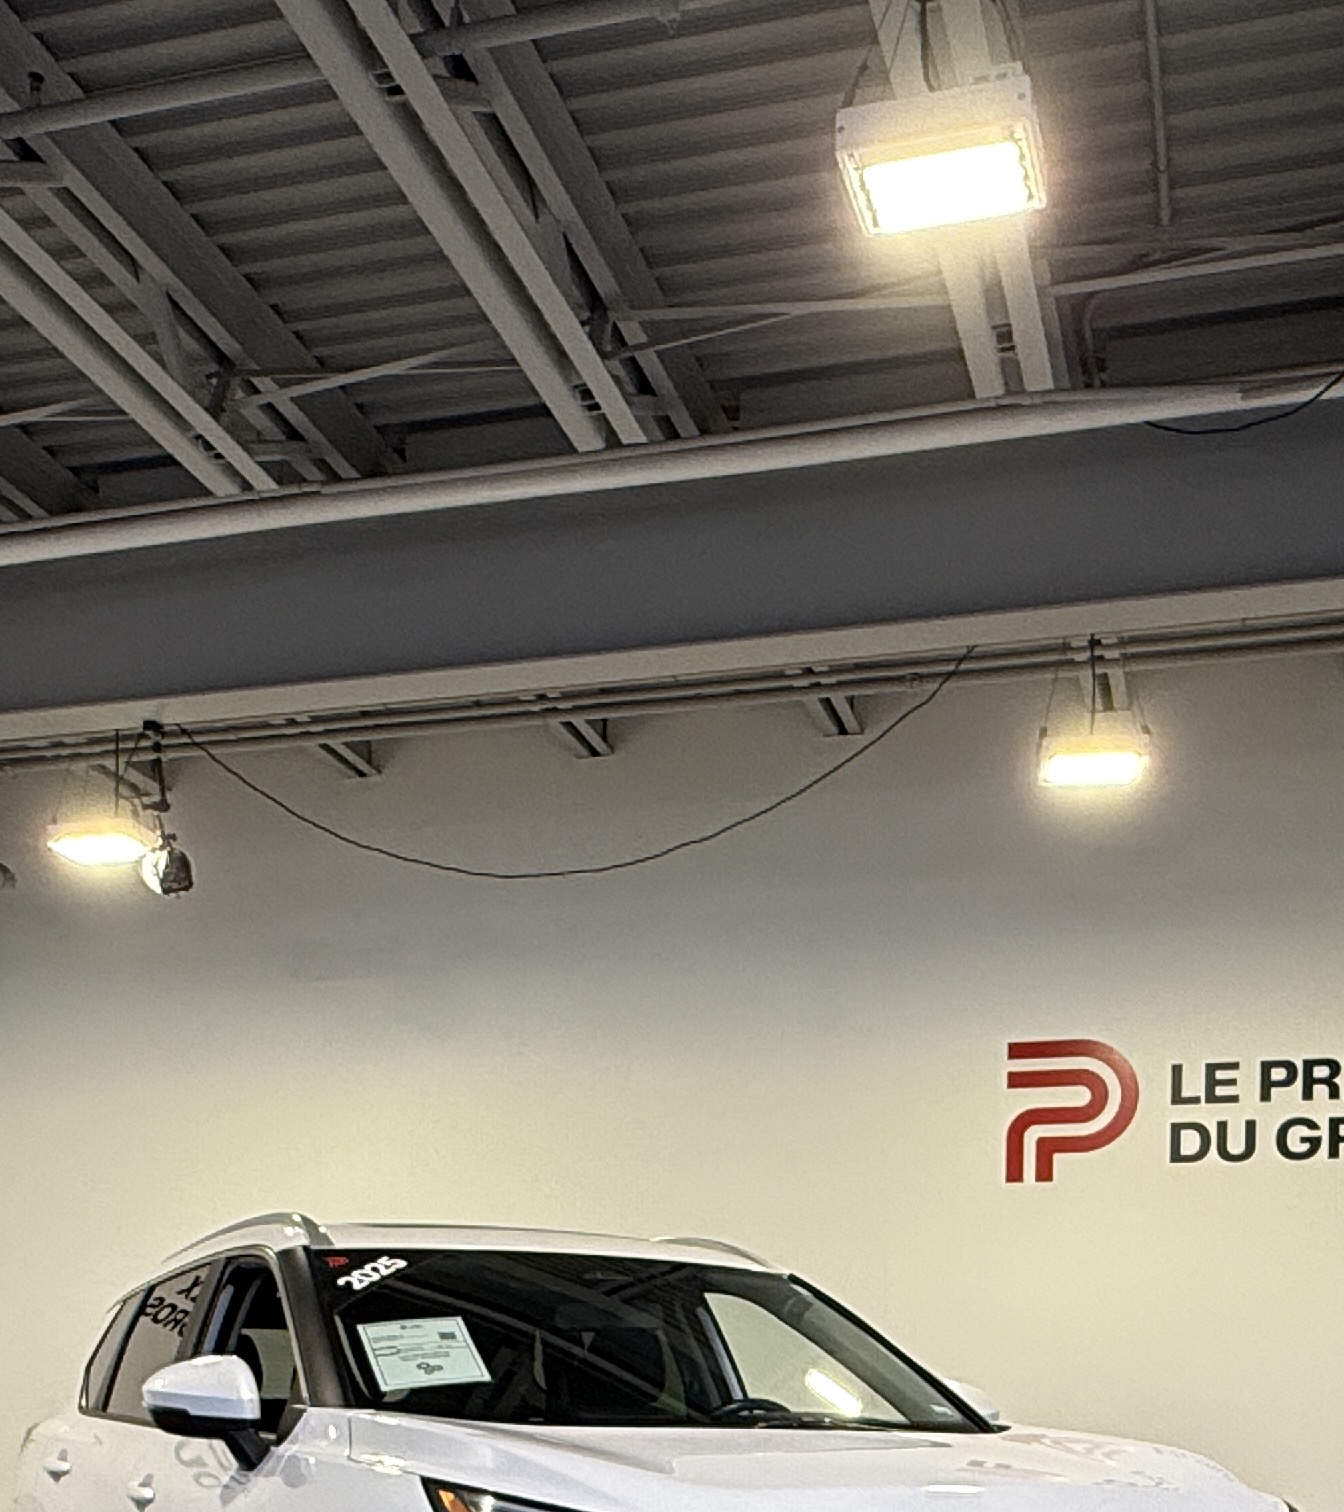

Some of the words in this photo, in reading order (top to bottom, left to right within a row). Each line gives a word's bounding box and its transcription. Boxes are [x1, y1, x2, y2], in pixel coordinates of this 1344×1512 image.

[1170, 1060, 1241, 1106] LE
[1168, 1118, 1257, 1164] DU
[336, 1255, 408, 1291] 2025
